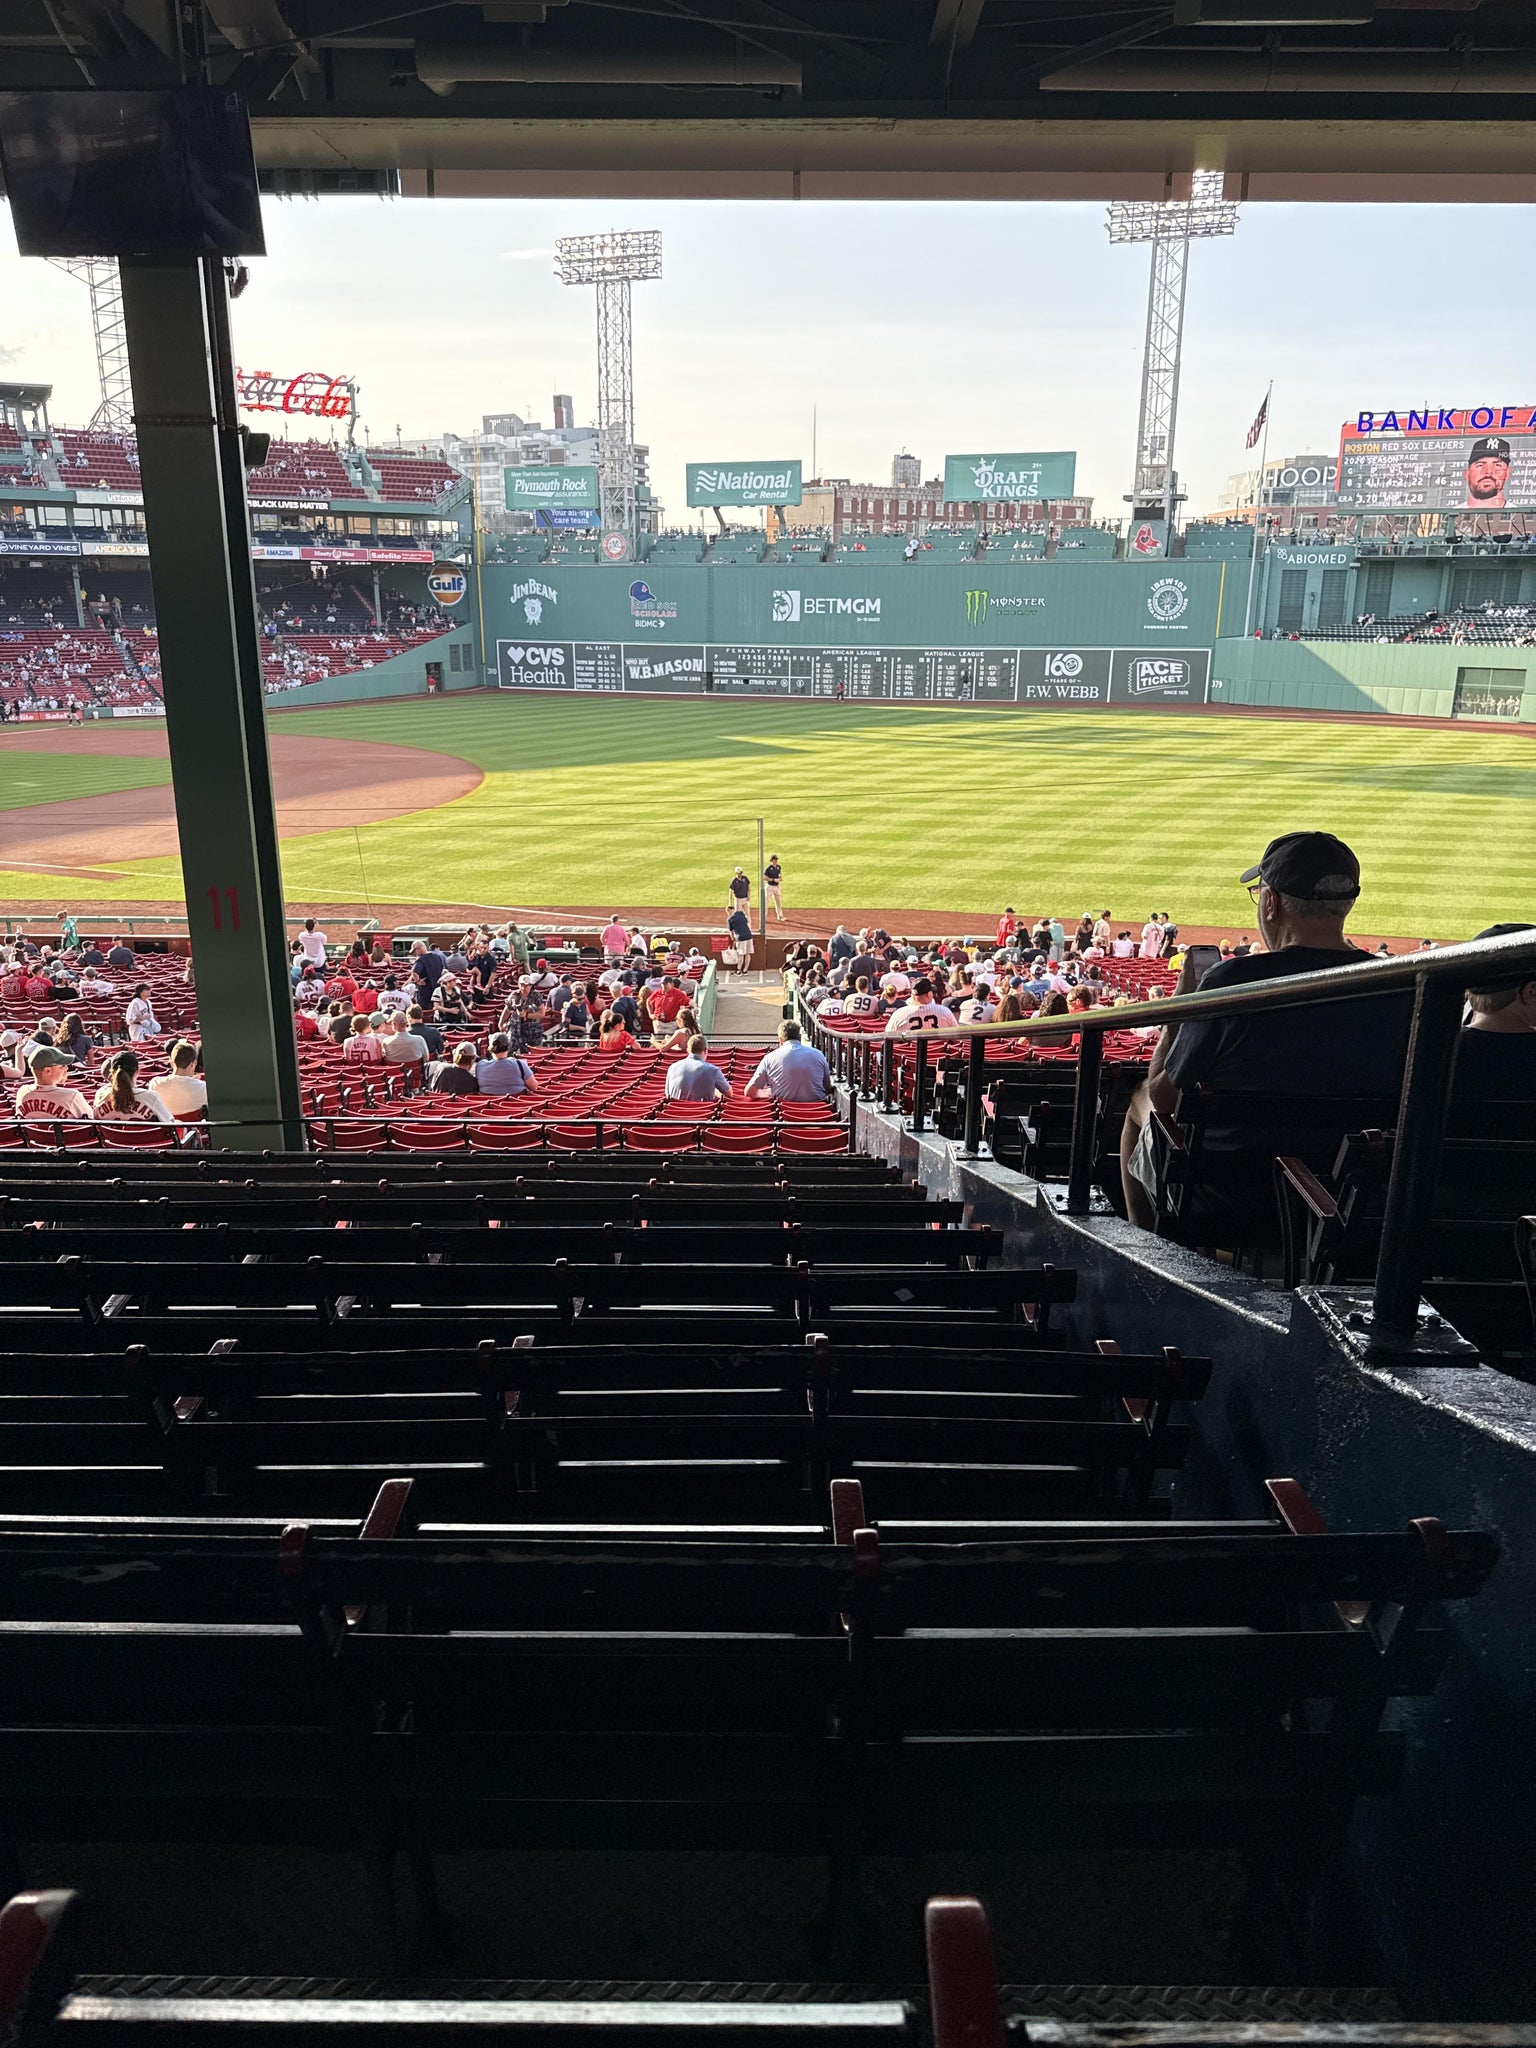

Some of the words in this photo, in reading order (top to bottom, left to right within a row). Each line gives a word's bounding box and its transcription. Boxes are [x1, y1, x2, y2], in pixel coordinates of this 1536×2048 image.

[1357, 408, 1457, 433] BANK
[1470, 406, 1518, 430] OF
[1345, 444, 1380, 454] BOSTON
[1382, 442, 1400, 451] RED
[1402, 442, 1420, 450] SOX
[1422, 440, 1465, 450] LEADERS
[1344, 457, 1365, 465] 2026
[1247, 466, 1338, 487] WHOOP
[1347, 467, 1353, 475] G
[514, 478, 560, 493] Plymouth
[562, 477, 587, 491] Rock
[974, 471, 1042, 488] DRAFT
[1411, 477, 1424, 486] 22
[1434, 476, 1447, 485] 46
[742, 491, 758, 499] Car
[759, 490, 788, 499] Rental
[981, 484, 1038, 498] KINGS
[252, 500, 277, 508] BLACK
[278, 501, 299, 509] LIVES
[299, 502, 329, 510] MATTER
[370, 552, 402, 560] Safelite
[1287, 553, 1347, 564] ABIOMED
[428, 577, 463, 591] Gulf
[1150, 577, 1174, 592] IBEW
[1173, 579, 1188, 592] 103
[635, 602, 655, 611] RED
[656, 602, 678, 611] SOX
[803, 598, 881, 614] BETMGM
[989, 596, 1046, 608] MONSTER
[634, 610, 678, 618] SCHOLARS
[635, 619, 658, 628] BIDMC
[525, 646, 565, 666] CVS
[1044, 653, 1084, 677] 160
[1140, 660, 1184, 677] ACE
[509, 666, 567, 685] Health
[1140, 675, 1184, 687] TICKET
[1211, 679, 1223, 689] 379
[1025, 685, 1052, 698] F.W.
[1057, 685, 1099, 699] WEBB
[205, 886, 241, 930] 11
[328, 986, 344, 999] 27
[853, 997, 871, 1011] 99
[971, 1006, 984, 1021] 2
[908, 1014, 938, 1031] 23
[350, 1050, 371, 1061] 50
[18, 1098, 72, 1120] ONTRERAS
